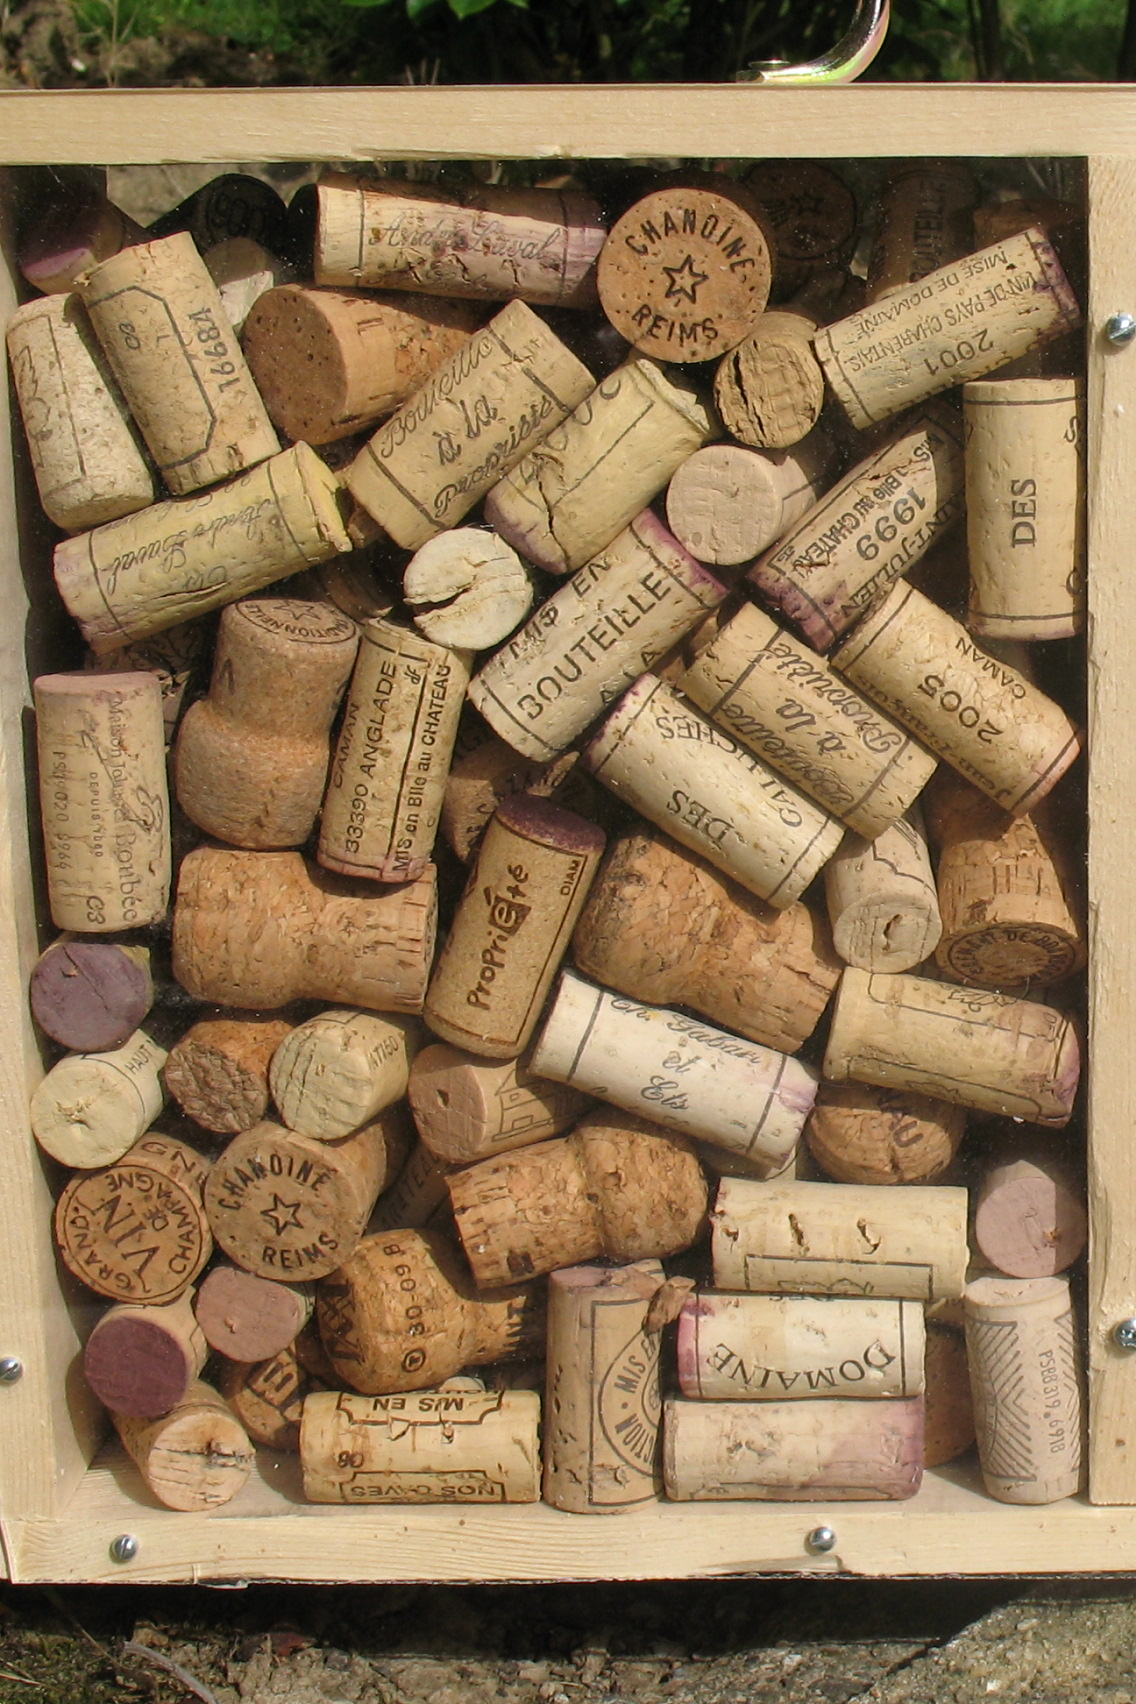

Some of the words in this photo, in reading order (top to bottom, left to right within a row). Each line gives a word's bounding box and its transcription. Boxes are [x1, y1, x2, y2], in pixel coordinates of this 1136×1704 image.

[624, 205, 756, 277] CHANOINE
[964, 248, 1006, 279] MISE
[933, 271, 955, 294] DE
[630, 302, 721, 346] REIMS
[851, 285, 931, 337] DOMAINE
[922, 327, 993, 373] 2001
[464, 394, 499, 439] la
[851, 486, 928, 563] 1999
[1011, 477, 1039, 549] DES
[567, 551, 614, 598] EN
[514, 567, 673, 725] BOUTEILLE
[954, 638, 1026, 700] CAMAN
[420, 662, 452, 747] CHATEAU
[774, 697, 818, 734] la
[918, 673, 1005, 745] 2005
[331, 702, 360, 788] CAMAN
[342, 782, 372, 853] 33390
[357, 659, 398, 779] ANGLADE
[417, 750, 432, 771] au
[810, 730, 846, 759] à
[657, 714, 805, 829] GALUCHES
[404, 811, 419, 832] en
[666, 788, 732, 846] DES
[560, 859, 582, 897] DIAM
[123, 1043, 153, 1074] HAUT
[662, 1049, 696, 1076] et
[640, 1075, 691, 1112] Ets
[218, 1153, 331, 1211] CHANOINE
[105, 1172, 196, 1274] CHAMPAGNE
[142, 1206, 168, 1231] DE
[70, 1205, 135, 1289] GRAND
[76, 1194, 159, 1292] VIN
[262, 1232, 338, 1268] REIMS
[383, 1241, 402, 1257] B
[614, 1354, 646, 1393] MIS
[705, 1338, 895, 1390] DOMAINE
[372, 1398, 405, 1411] EN
[417, 1397, 463, 1411] MIS
[440, 1484, 494, 1495] NOS
